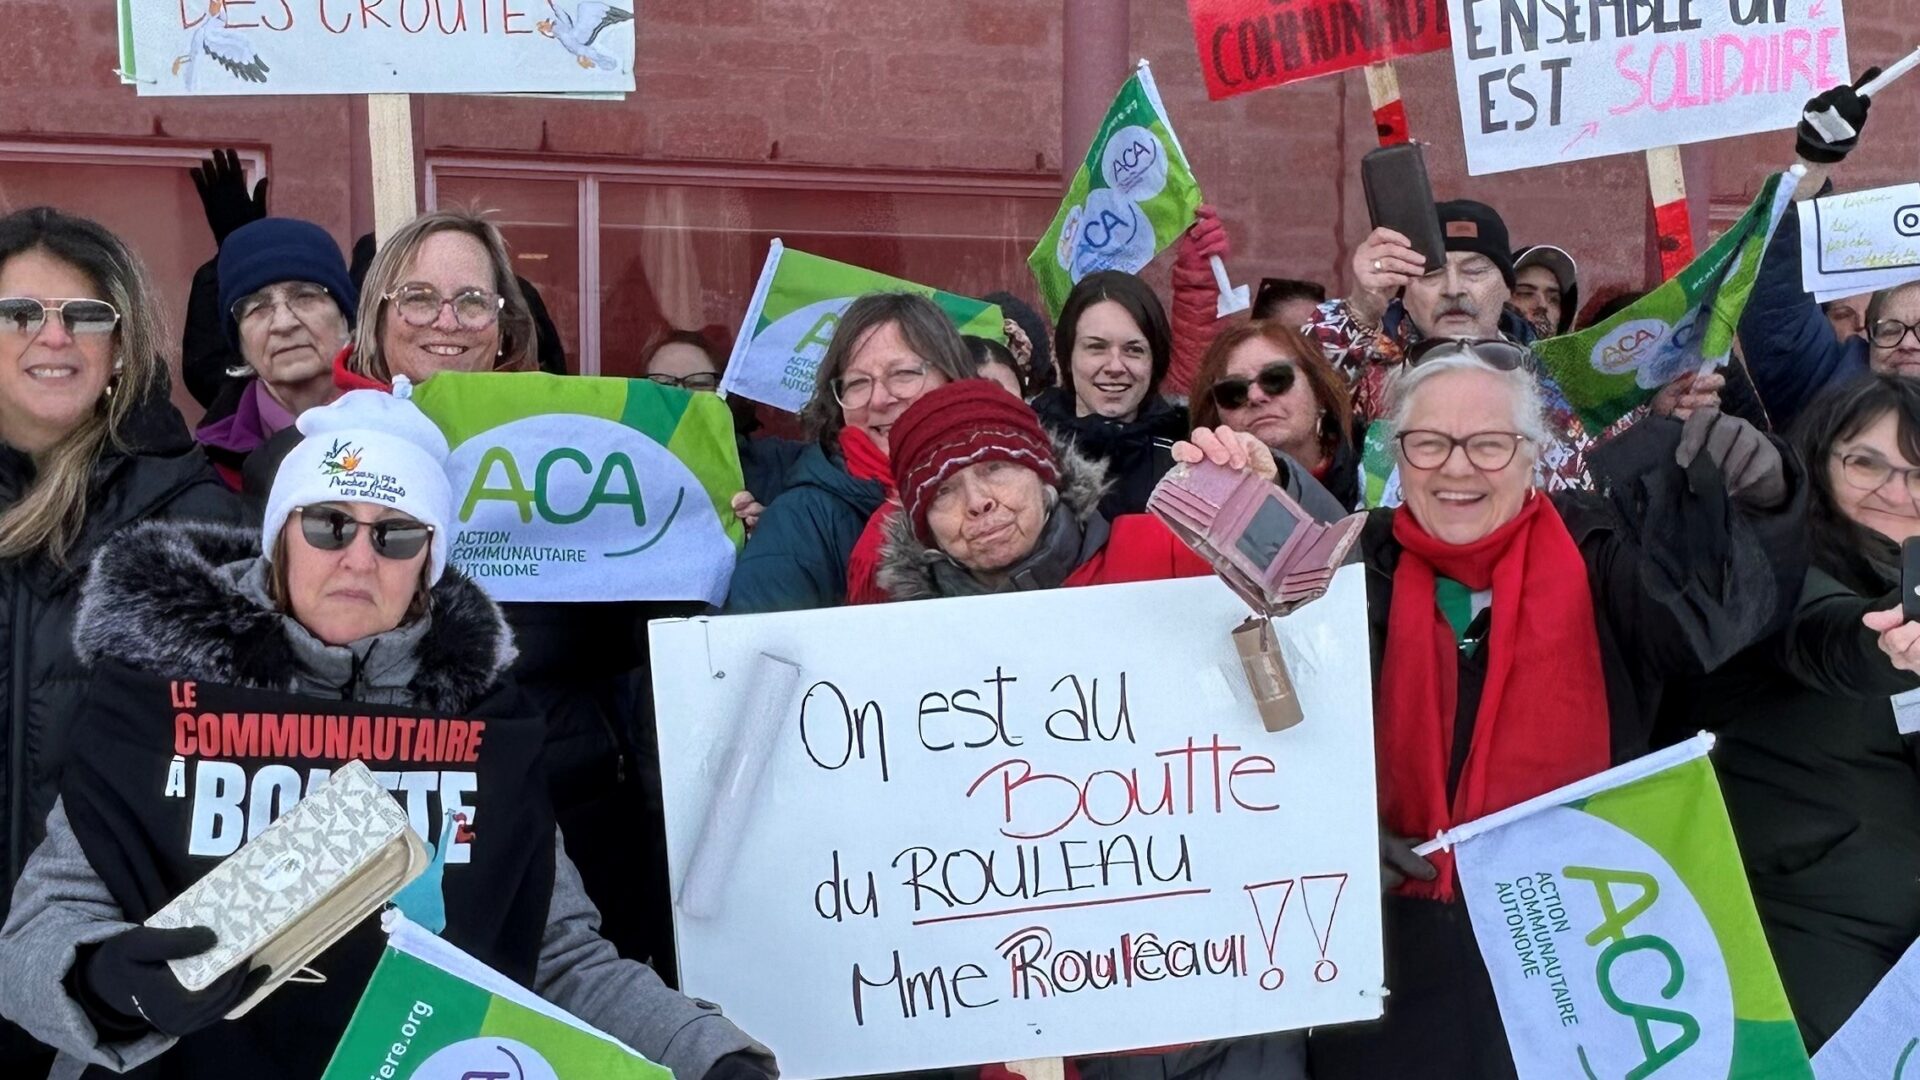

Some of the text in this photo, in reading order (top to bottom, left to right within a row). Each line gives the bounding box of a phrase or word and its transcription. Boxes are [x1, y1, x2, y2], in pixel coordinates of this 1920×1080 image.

[1478, 27, 1841, 134] EST SOLIDAIRE
[1113, 141, 1150, 182] ACA
[459, 446, 645, 527] ACA
[451, 545, 588, 563] COMMUNAUTAIRE
[454, 530, 511, 545] ACTION
[170, 680, 197, 708] LE
[800, 667, 1136, 782] On est au
[174, 712, 486, 763] COMMUNAUTAIRE
[188, 759, 478, 865] BOTE
[966, 733, 1281, 839] Boutte
[814, 834, 1194, 923] du ROULEAU
[1535, 871, 1571, 933] ACTION
[1495, 882, 1540, 979] AUTONOME
[1516, 876, 1578, 1027] COMMUNAUTAIRE
[1562, 865, 1701, 1080] ACA
[852, 950, 1000, 1027] Mme
